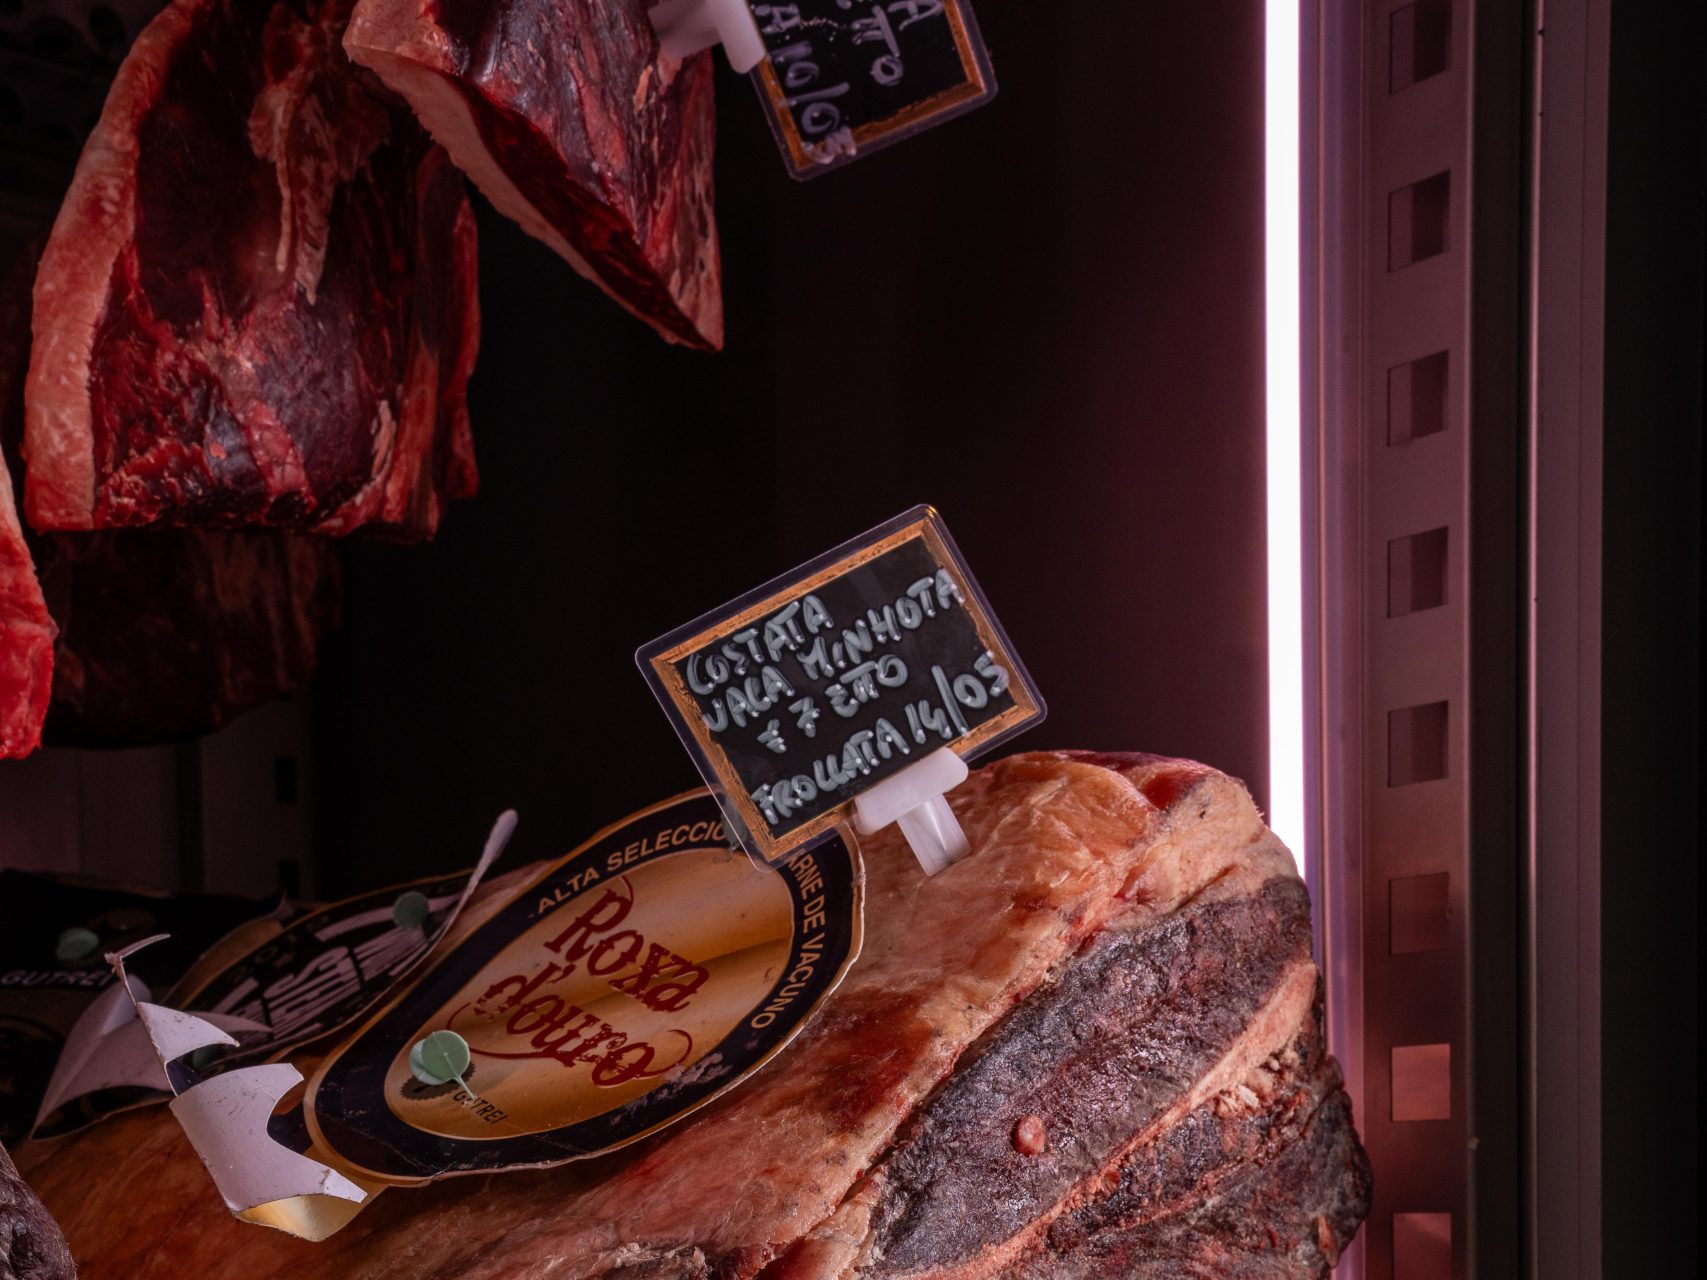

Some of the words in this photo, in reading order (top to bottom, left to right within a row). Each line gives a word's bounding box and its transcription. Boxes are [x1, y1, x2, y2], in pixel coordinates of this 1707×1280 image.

[686, 595, 835, 696] COSTATA
[702, 666, 796, 733] VACA
[797, 568, 966, 681] MINHOTA
[750, 717, 912, 826] FROLLATA
[904, 649, 1010, 746] 14/05
[538, 866, 600, 915] ALTA
[607, 820, 728, 872] SELECCIO
[788, 848, 824, 900] ARNE
[802, 894, 826, 934] DE
[751, 932, 826, 1030] VACUNO
